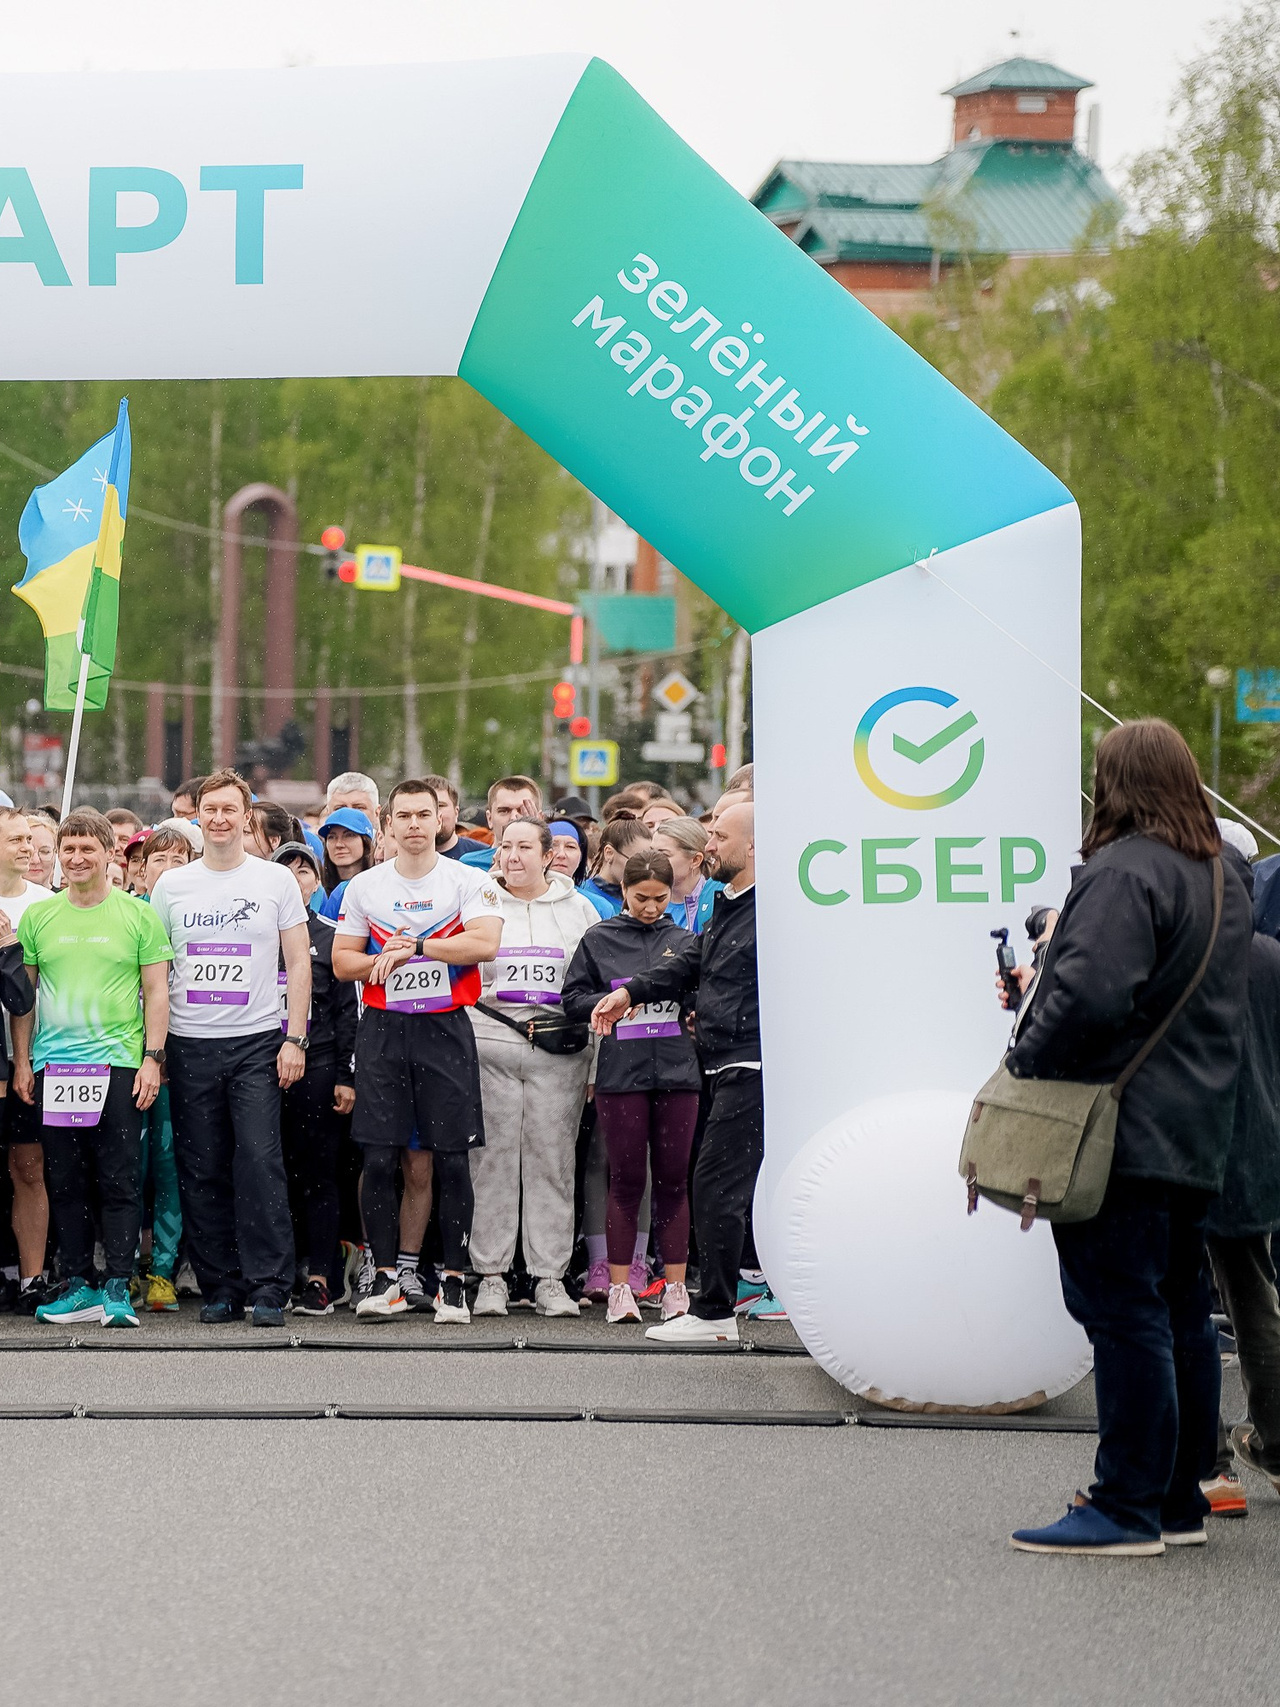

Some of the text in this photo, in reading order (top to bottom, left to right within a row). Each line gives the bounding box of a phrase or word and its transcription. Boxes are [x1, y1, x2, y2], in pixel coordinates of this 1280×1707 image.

[616, 252, 870, 474] зелёный
[571, 294, 816, 517] марафон
[798, 836, 1047, 906] СБЕР
[183, 910, 228, 928] Utair
[193, 963, 244, 982] 2072
[392, 969, 442, 991] 2289
[506, 964, 556, 983] 2153
[642, 999, 675, 1014] 152
[53, 1084, 103, 1103] 2185
